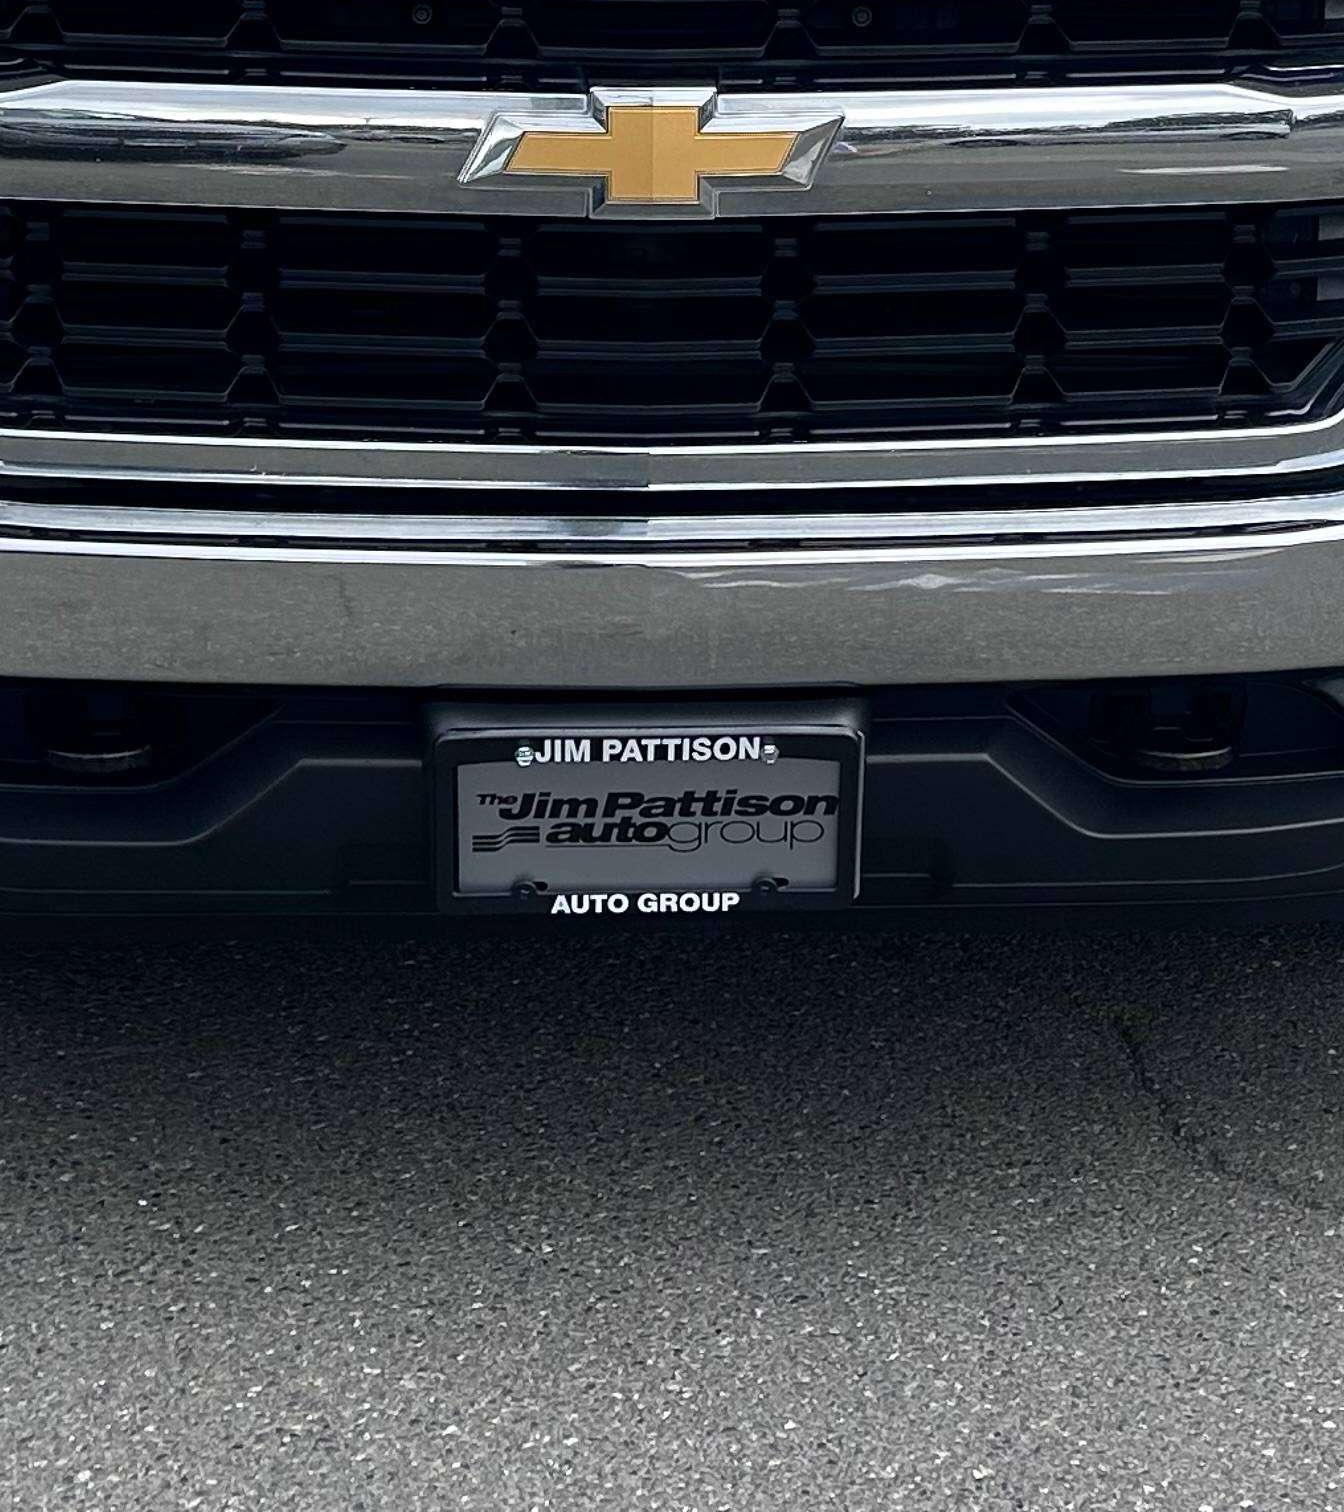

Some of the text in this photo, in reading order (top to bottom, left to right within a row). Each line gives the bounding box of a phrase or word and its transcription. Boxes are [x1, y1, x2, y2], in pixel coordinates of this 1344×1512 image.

[535, 737, 760, 763] JIM PATTISON
[476, 789, 840, 820] The Jim Pattison
[551, 892, 740, 915] AUTO GROUP
